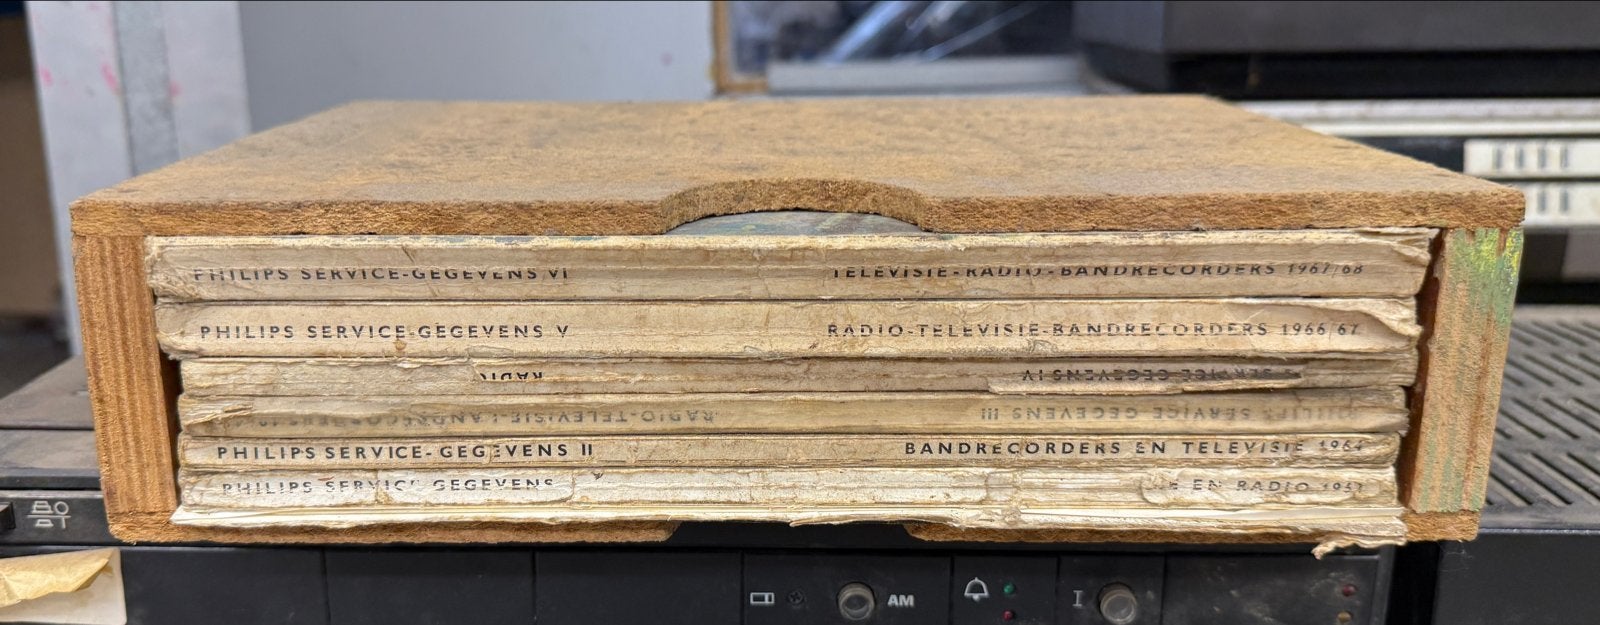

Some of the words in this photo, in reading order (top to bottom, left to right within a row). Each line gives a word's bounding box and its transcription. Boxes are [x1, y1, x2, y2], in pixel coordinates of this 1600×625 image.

[193, 268, 289, 281] PHILIPS
[549, 267, 568, 279] VI
[200, 325, 294, 339] PHILIPS
[556, 325, 569, 338] V
[479, 371, 544, 380] RADI
[1022, 369, 1043, 382] IV
[1012, 407, 1139, 420] GEGEVENS
[1153, 407, 1251, 420] SERVICE
[217, 446, 316, 460] PHILIPS
[581, 443, 593, 456] II
[905, 441, 1121, 455] BANDRECORDERS
[1136, 440, 1165, 454] EN
[1182, 440, 1304, 454] TELEVISIE
[222, 481, 312, 495] PHILIPS
[433, 478, 553, 492] GEGEVENS
[1193, 479, 1222, 491] EN
[1236, 480, 1309, 493] RADIO
[887, 594, 915, 607] AM
